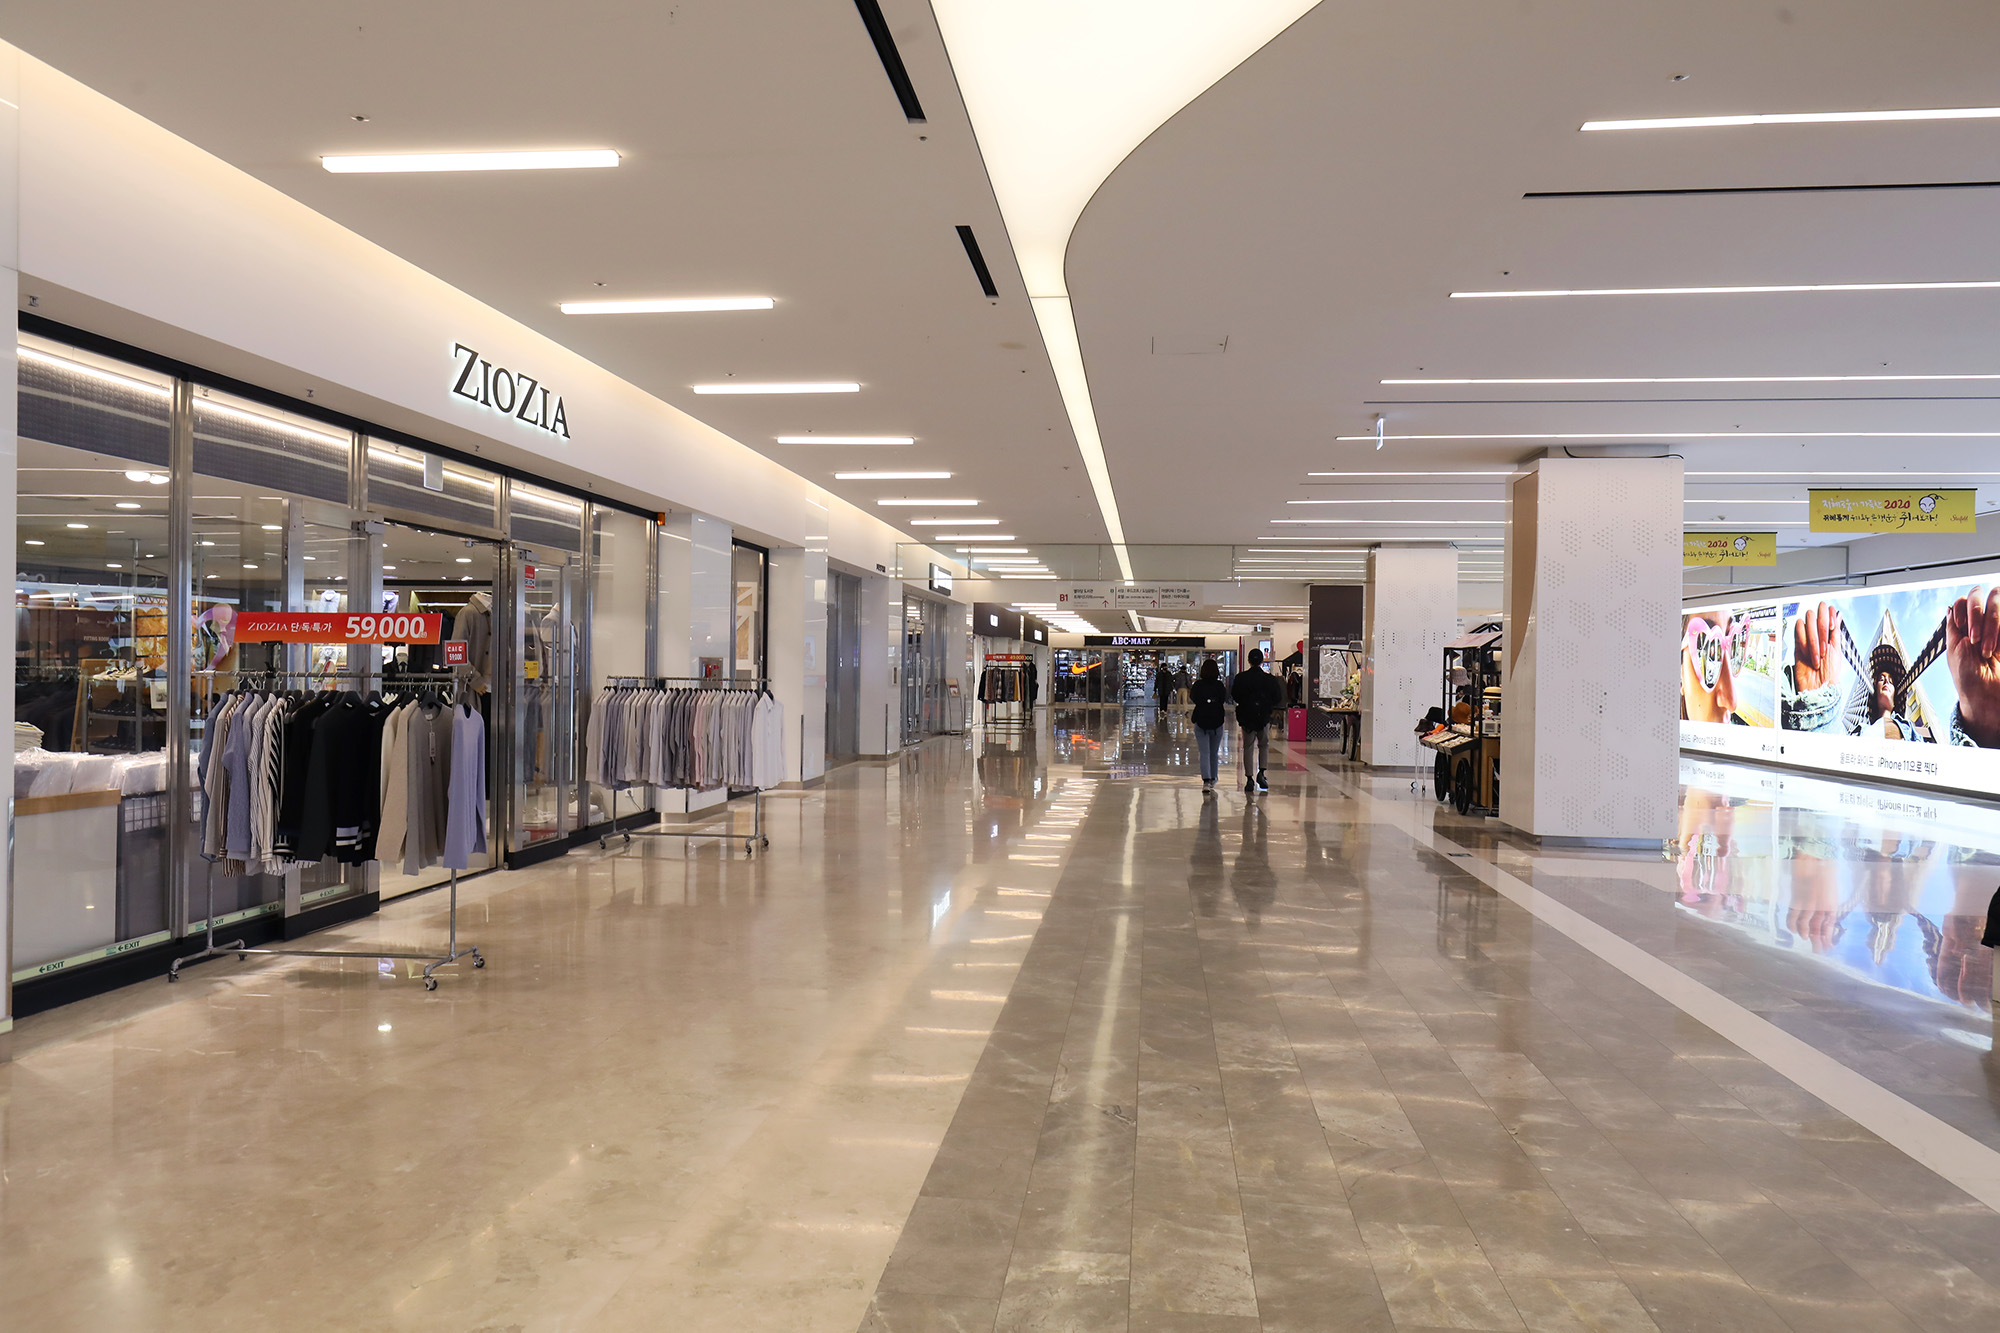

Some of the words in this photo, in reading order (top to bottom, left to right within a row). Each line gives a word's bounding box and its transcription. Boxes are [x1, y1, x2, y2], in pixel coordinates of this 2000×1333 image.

[453, 342, 570, 439] ZIOZIA
[1884, 499, 1911, 509] 2020
[1707, 540, 1728, 548] 2020
[247, 622, 289, 632] ZIOZIA
[345, 616, 425, 640] 59,000
[1877, 756, 1903, 771] iPhone
[1903, 760, 1922, 773] 11으로
[1924, 761, 1938, 776] 찍다
[124, 940, 140, 951] EXIT
[46, 960, 65, 972] EXIT
